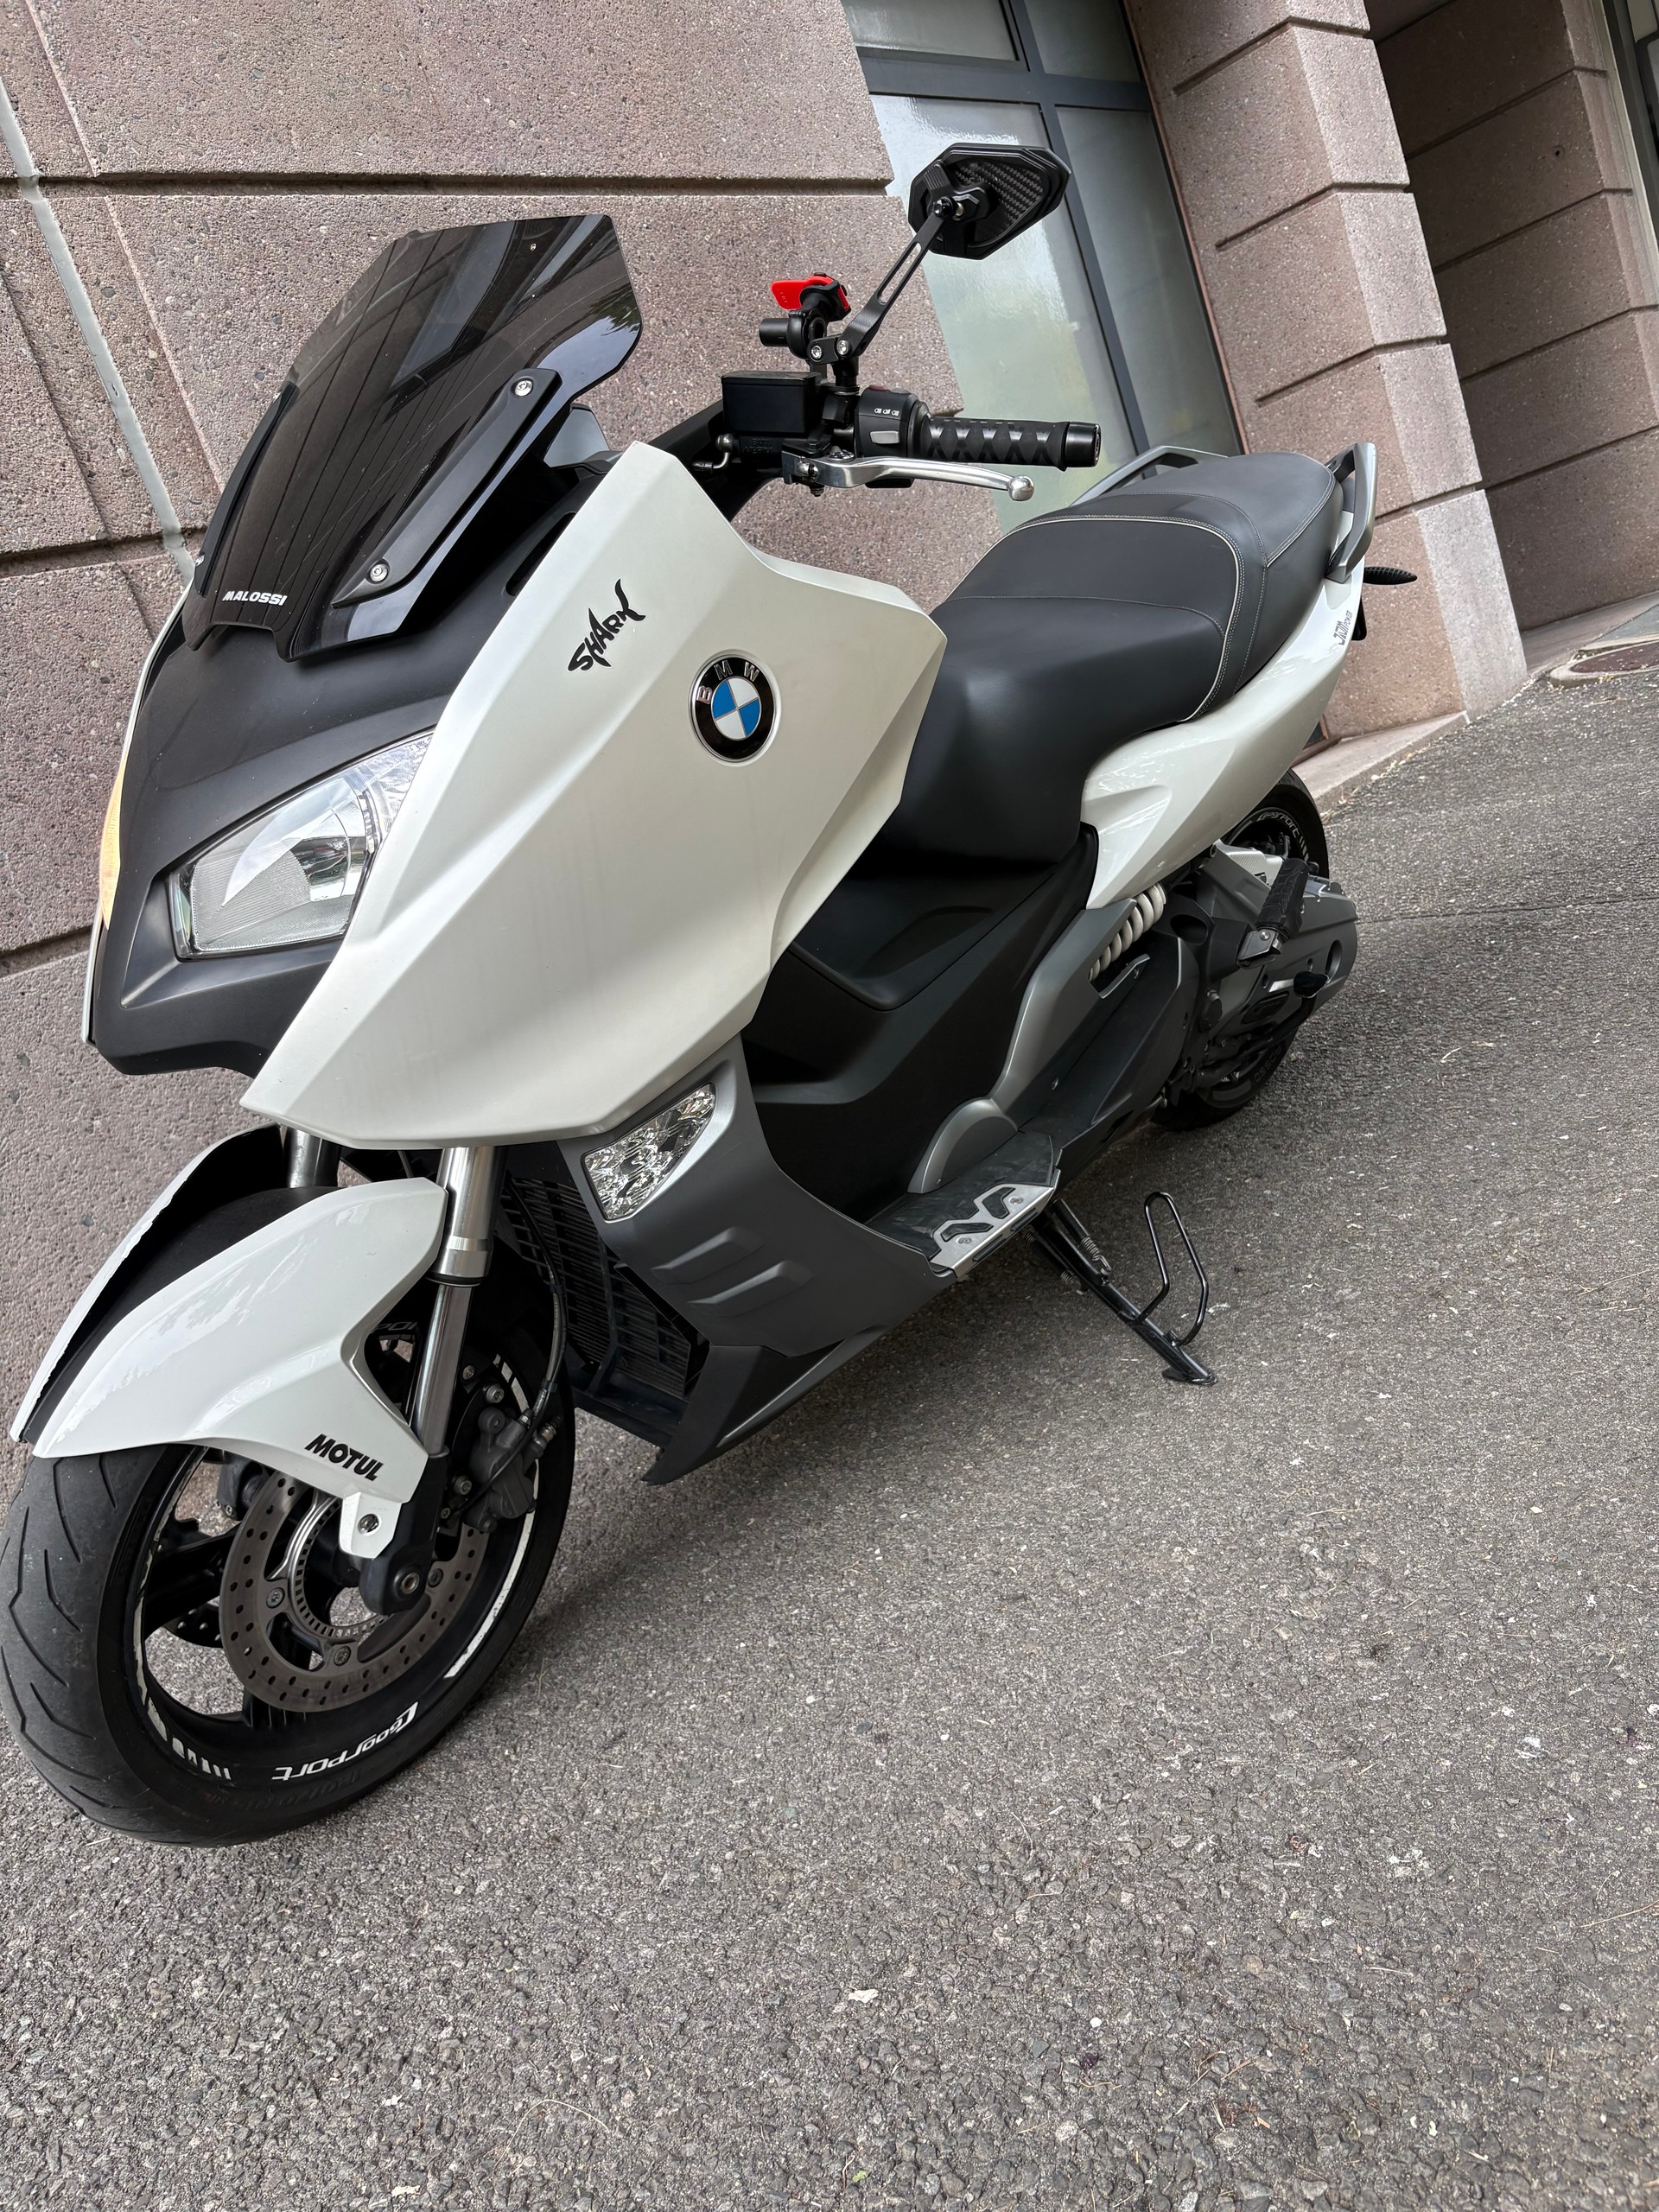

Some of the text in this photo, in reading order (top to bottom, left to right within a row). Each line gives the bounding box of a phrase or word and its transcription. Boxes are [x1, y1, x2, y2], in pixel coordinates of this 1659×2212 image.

[222, 590, 288, 607] MALOSSI
[567, 578, 646, 672] SHARK
[696, 659, 760, 705] BMW
[304, 1433, 384, 1482] MOTUL
